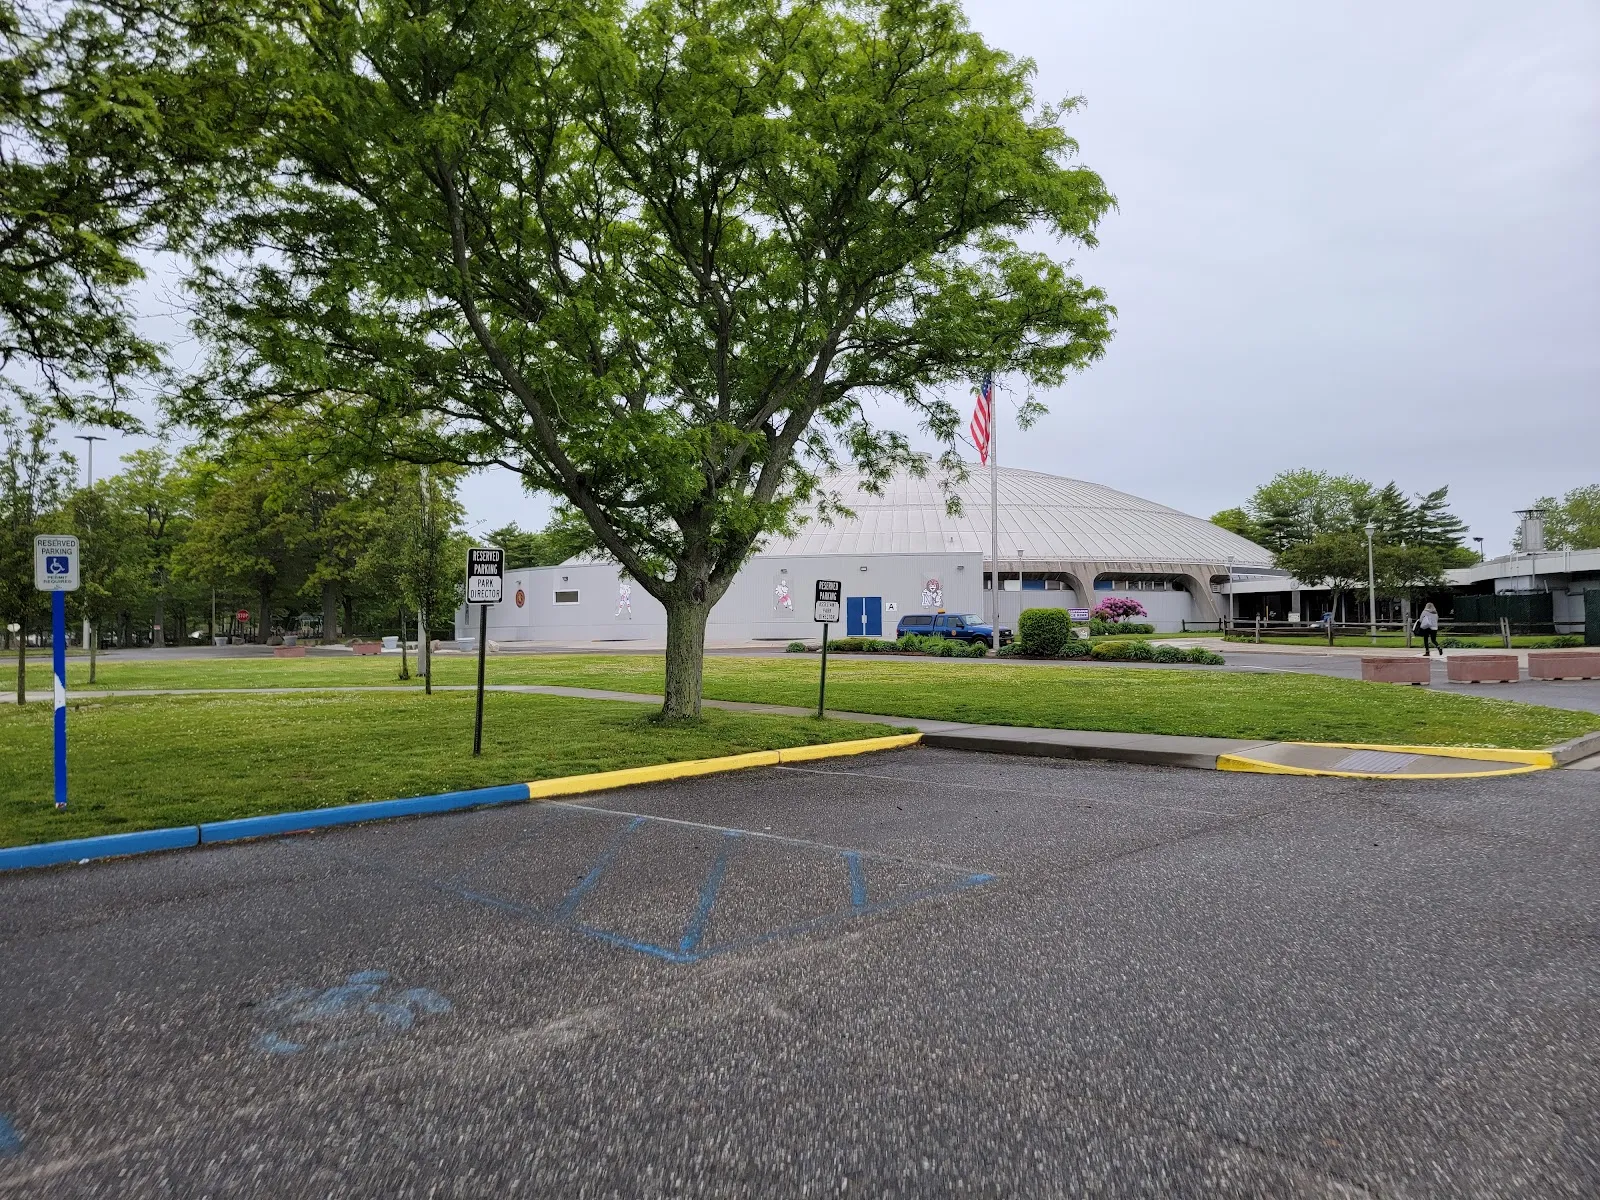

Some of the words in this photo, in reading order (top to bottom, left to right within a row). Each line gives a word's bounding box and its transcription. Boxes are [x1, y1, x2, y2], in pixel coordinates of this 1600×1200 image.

[472, 550, 500, 562] RESERVED
[473, 563, 498, 575] PARKING
[477, 578, 494, 588] PARK
[818, 580, 839, 591] RESERVED
[470, 589, 500, 599] DIRECTOR
[819, 591, 837, 601] PARKING
